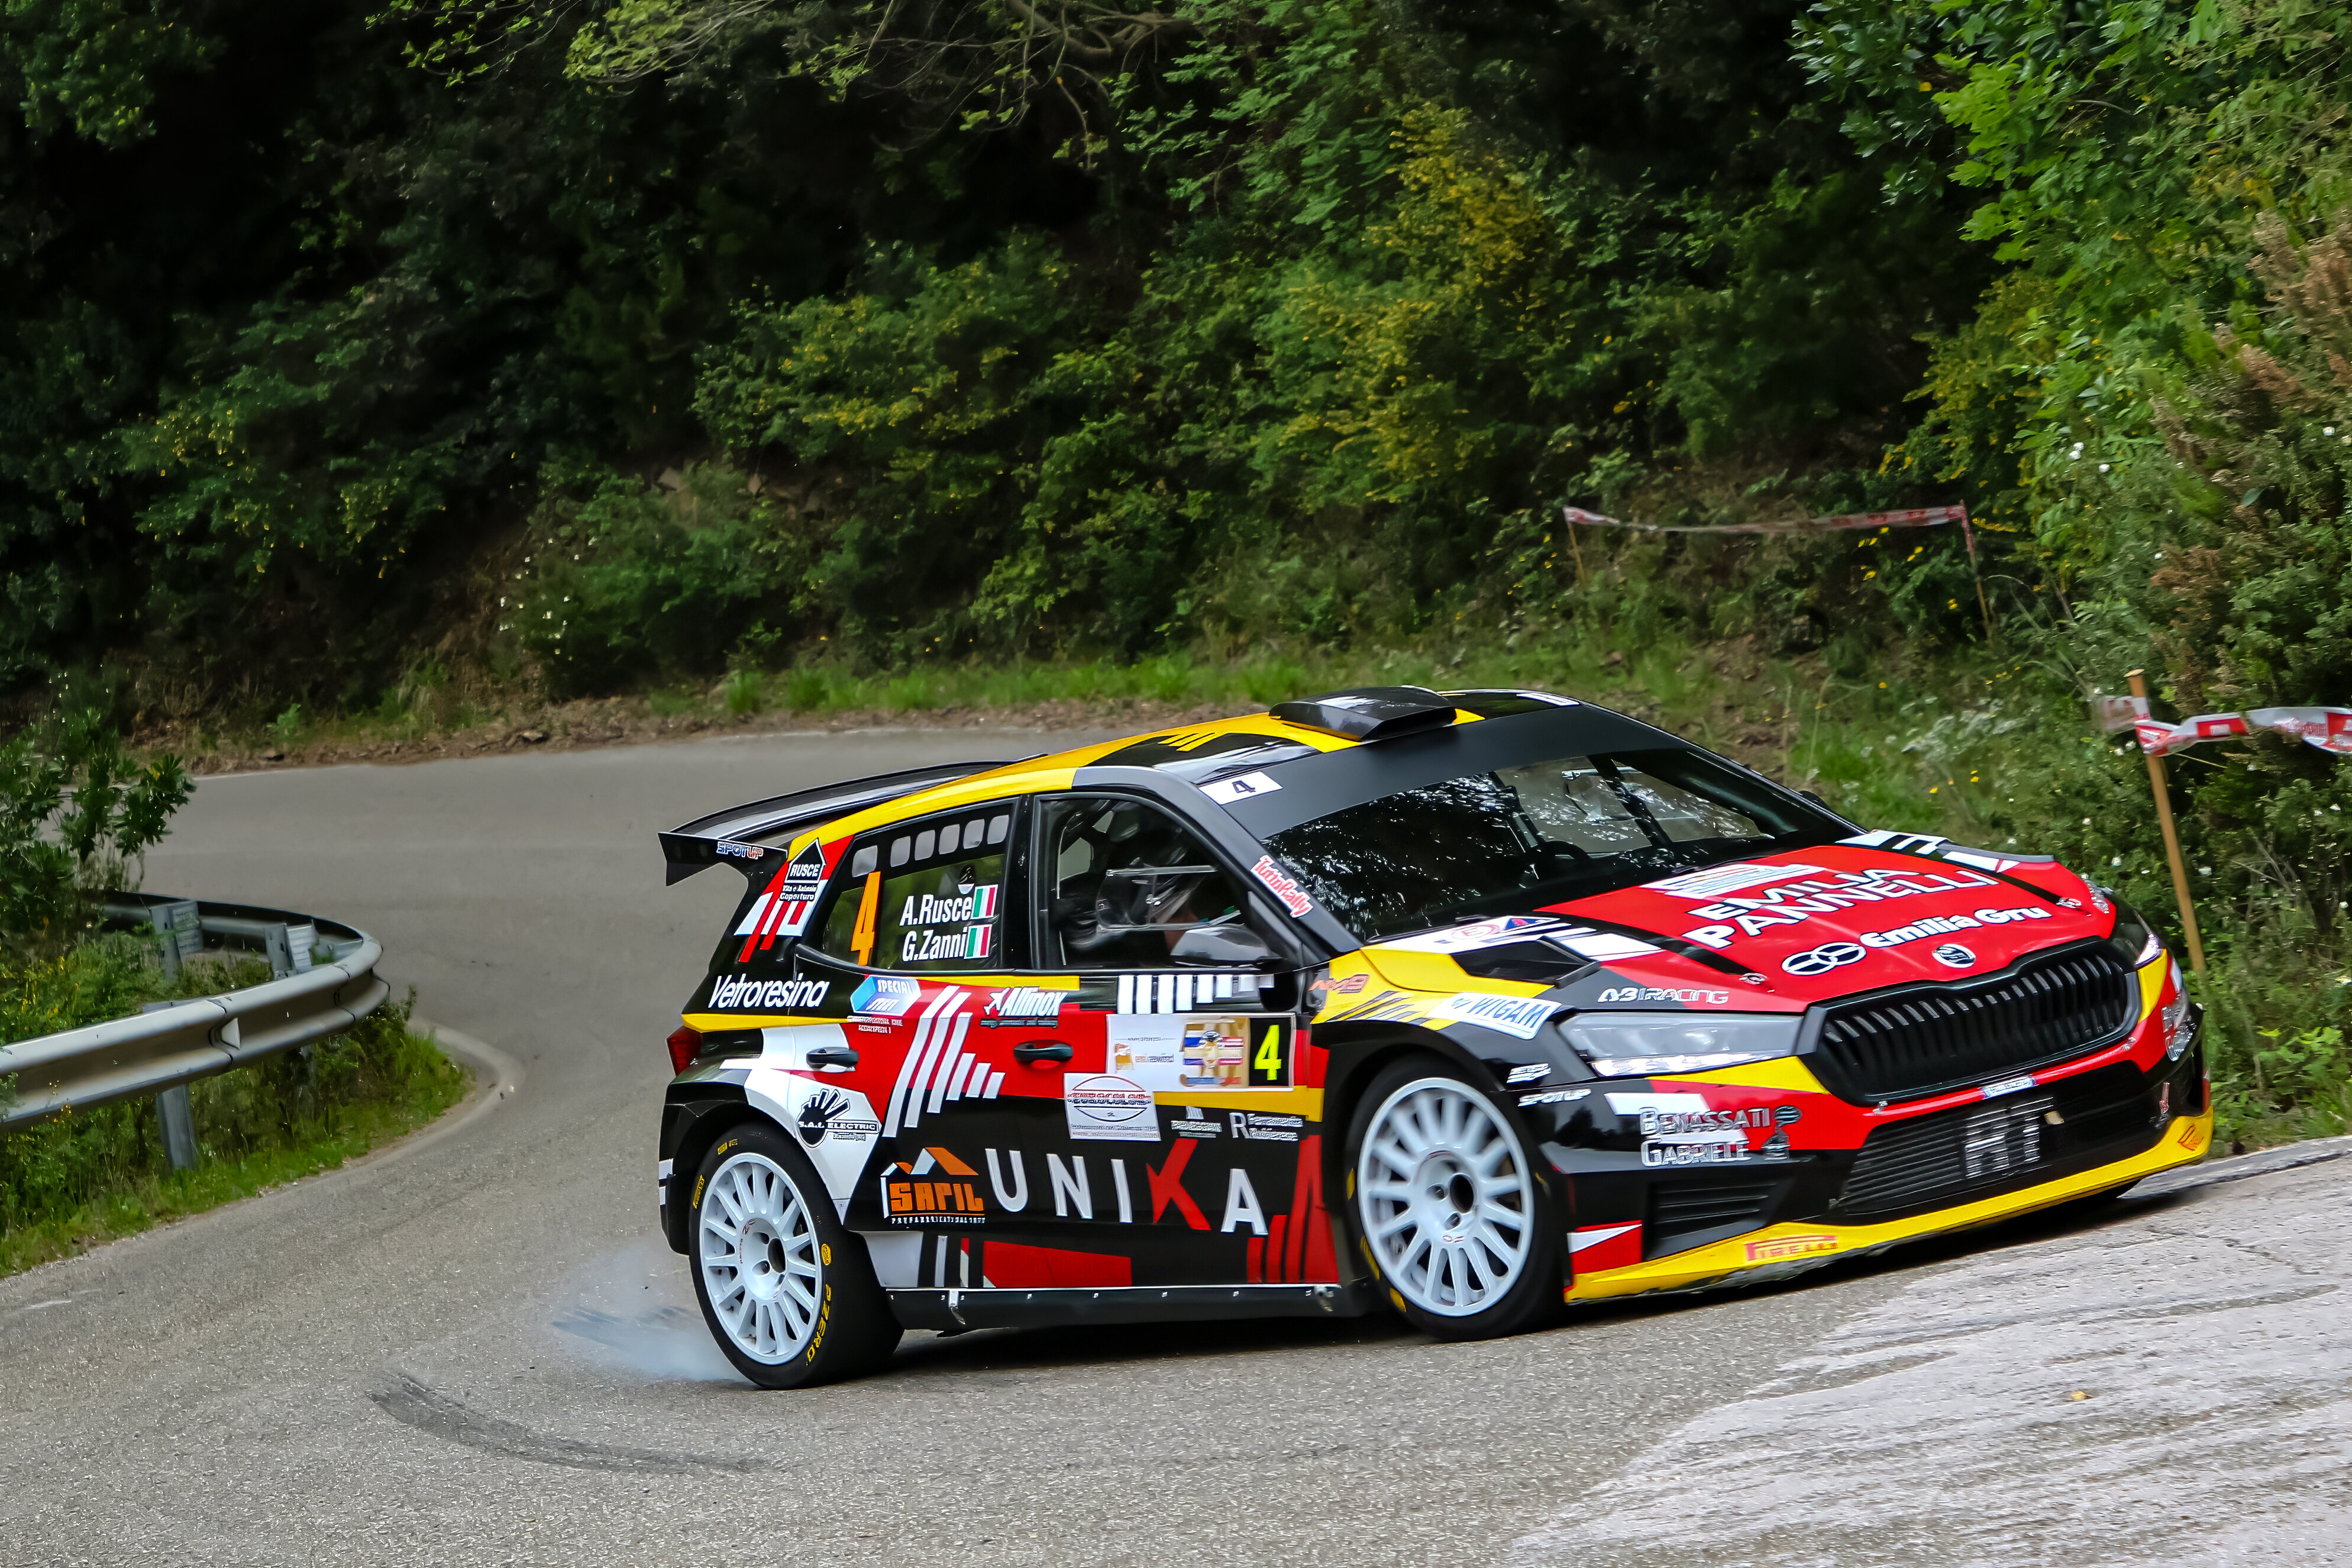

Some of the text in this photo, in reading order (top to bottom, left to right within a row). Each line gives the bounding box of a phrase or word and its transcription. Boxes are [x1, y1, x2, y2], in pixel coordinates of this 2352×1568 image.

[1231, 780, 1256, 793] 4
[790, 864, 820, 877] RUSCE
[900, 893, 971, 926] A.Rusce
[1681, 870, 1999, 949] PANNELLI
[1687, 868, 1920, 920] EMILIA
[850, 871, 881, 965] 4
[1860, 906, 2051, 948] Emilia Gru
[903, 927, 968, 961] G.Zanni
[708, 973, 829, 1008] Vetroresina
[1466, 996, 1550, 1028] WIGAM
[1254, 1024, 1282, 1080] 4
[827, 1122, 875, 1130] ELECTRIC
[985, 1137, 1268, 1235] UNIKA
